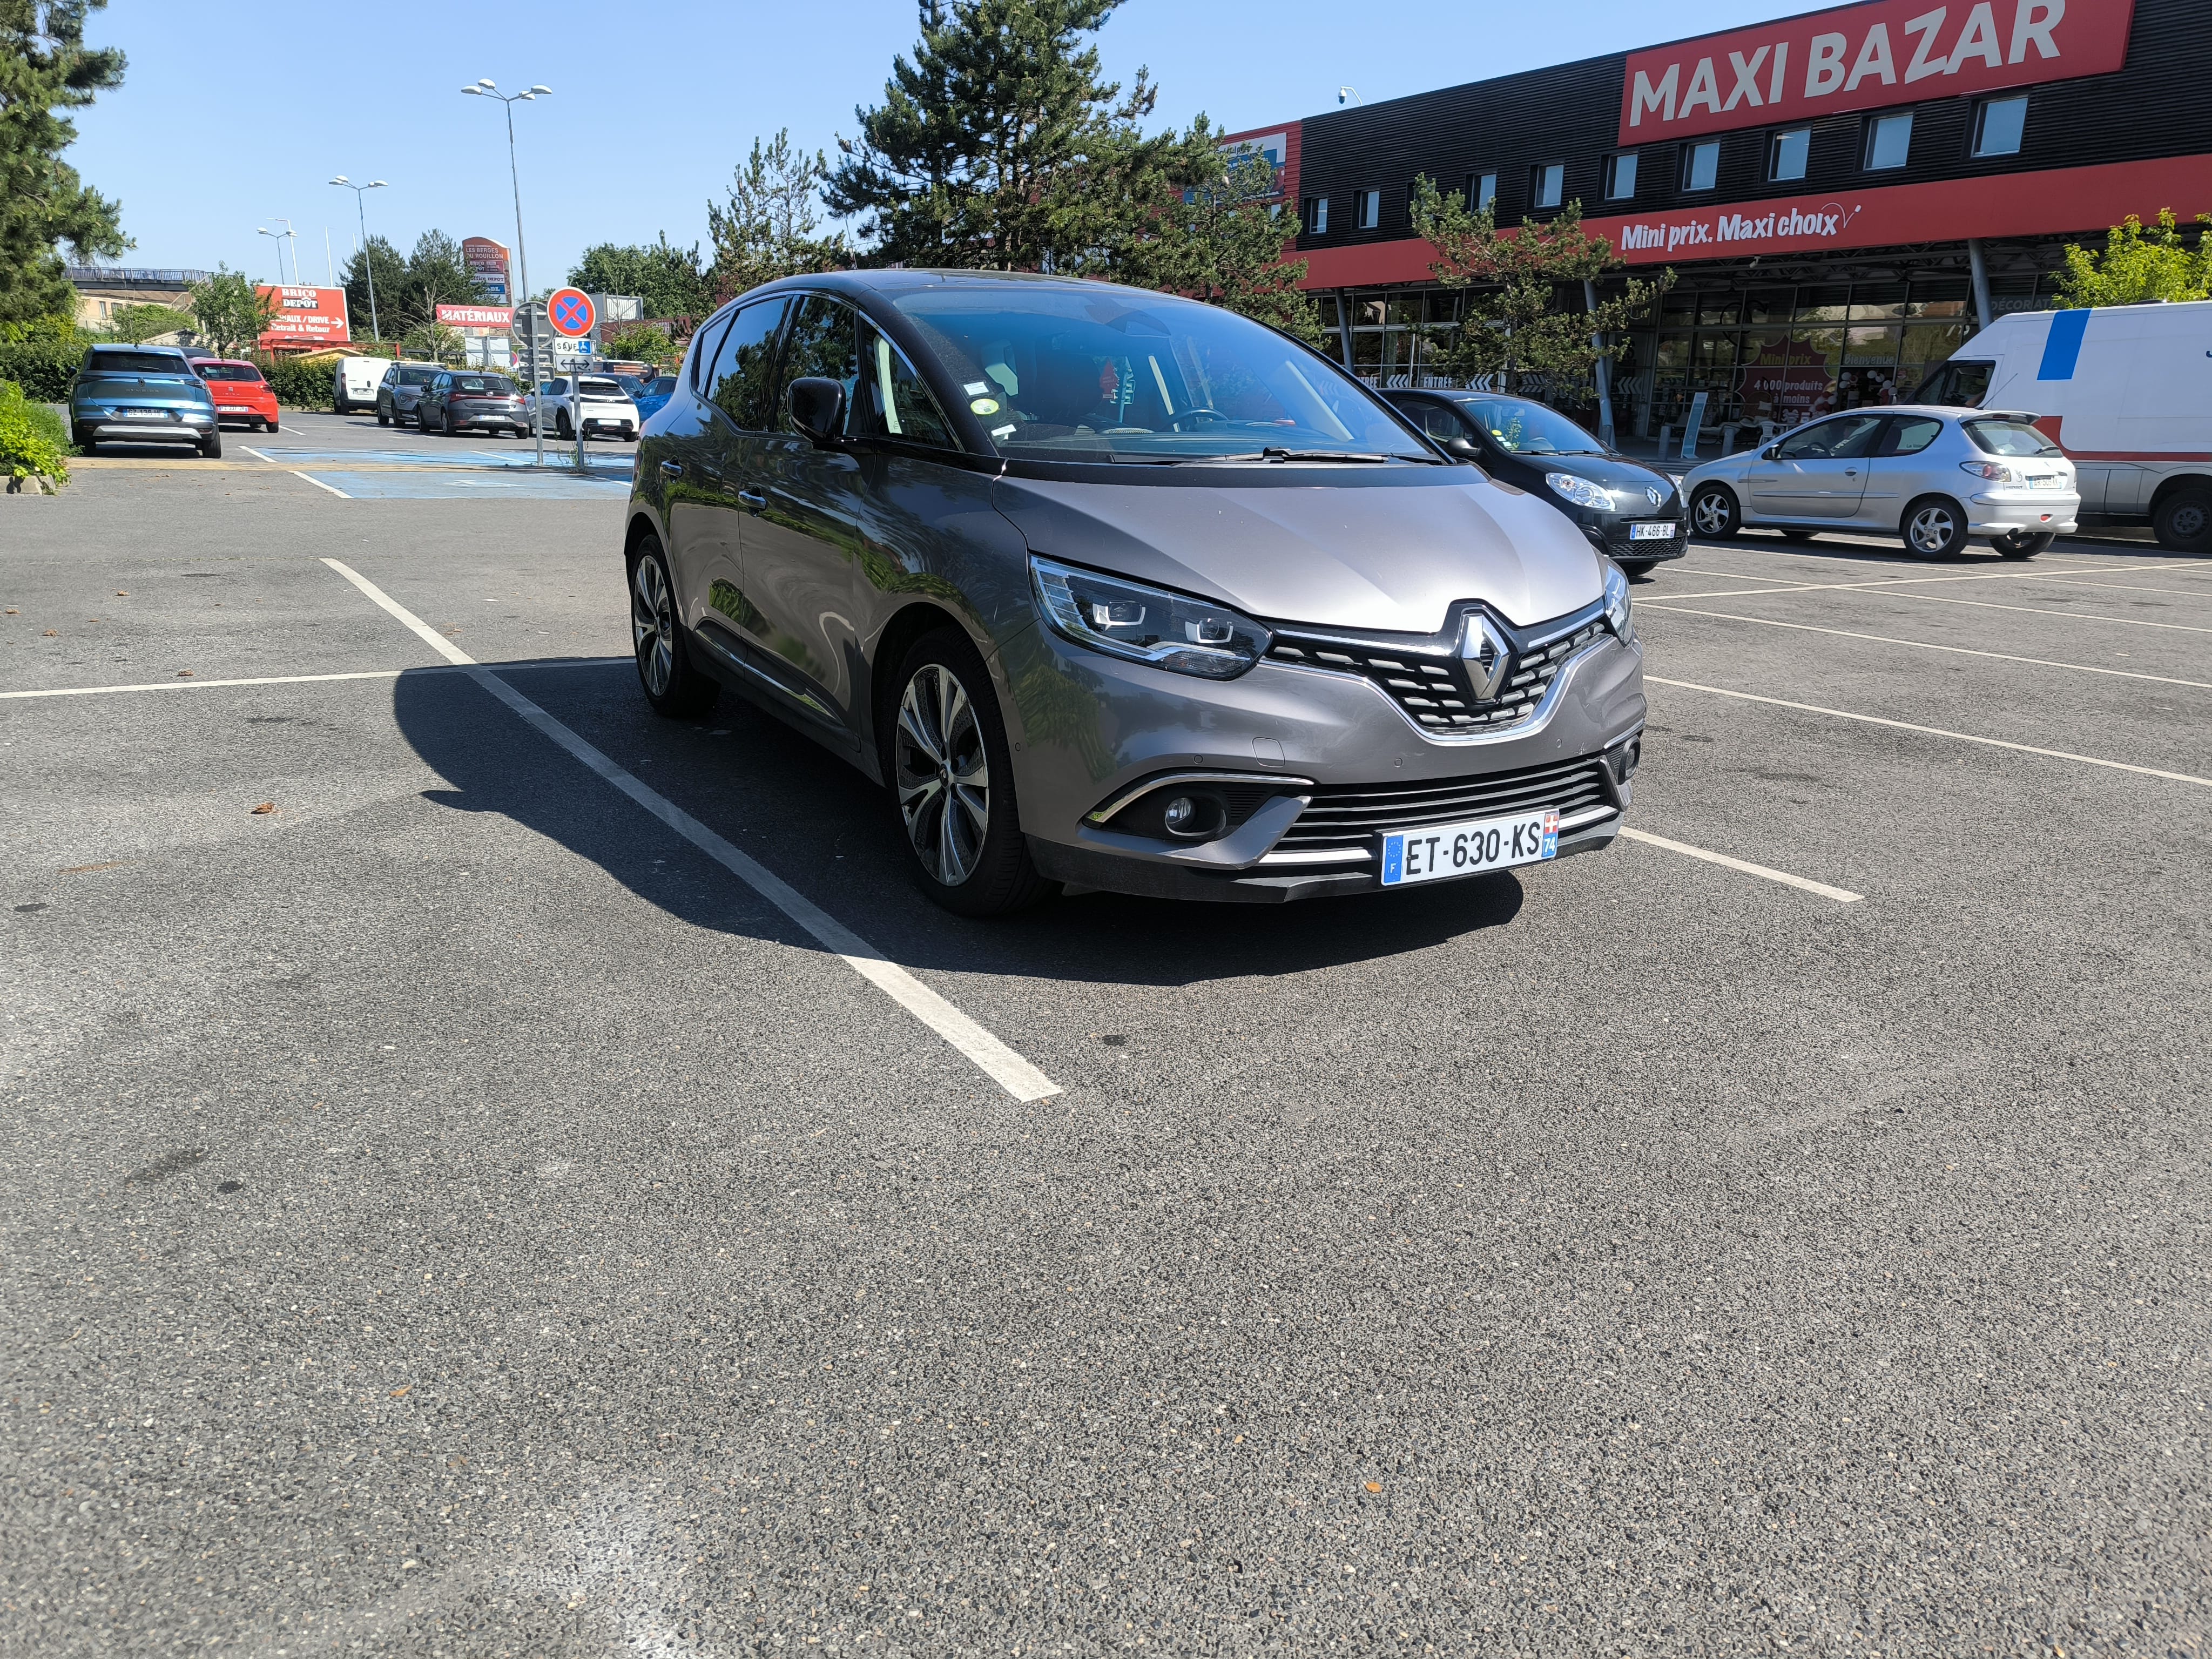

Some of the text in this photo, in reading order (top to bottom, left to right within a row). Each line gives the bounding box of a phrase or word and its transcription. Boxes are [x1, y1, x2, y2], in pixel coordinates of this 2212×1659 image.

[1629, 0, 2066, 127] MAXI BAZAR
[1621, 207, 1839, 252] Mini prix. Maxi choix
[281, 288, 316, 297] BRICO
[308, 316, 329, 324] DRIVE
[442, 308, 510, 323] MATÉRIAUX
[1760, 354, 1785, 365] Mini
[1844, 354, 1894, 365] Bienvenue
[1784, 380, 1823, 392] produits
[1783, 394, 1810, 403] moins
[1636, 525, 1669, 537] HK-466-BL
[1406, 821, 1540, 875] ET-630-KS
[1544, 838, 1556, 853] 74
